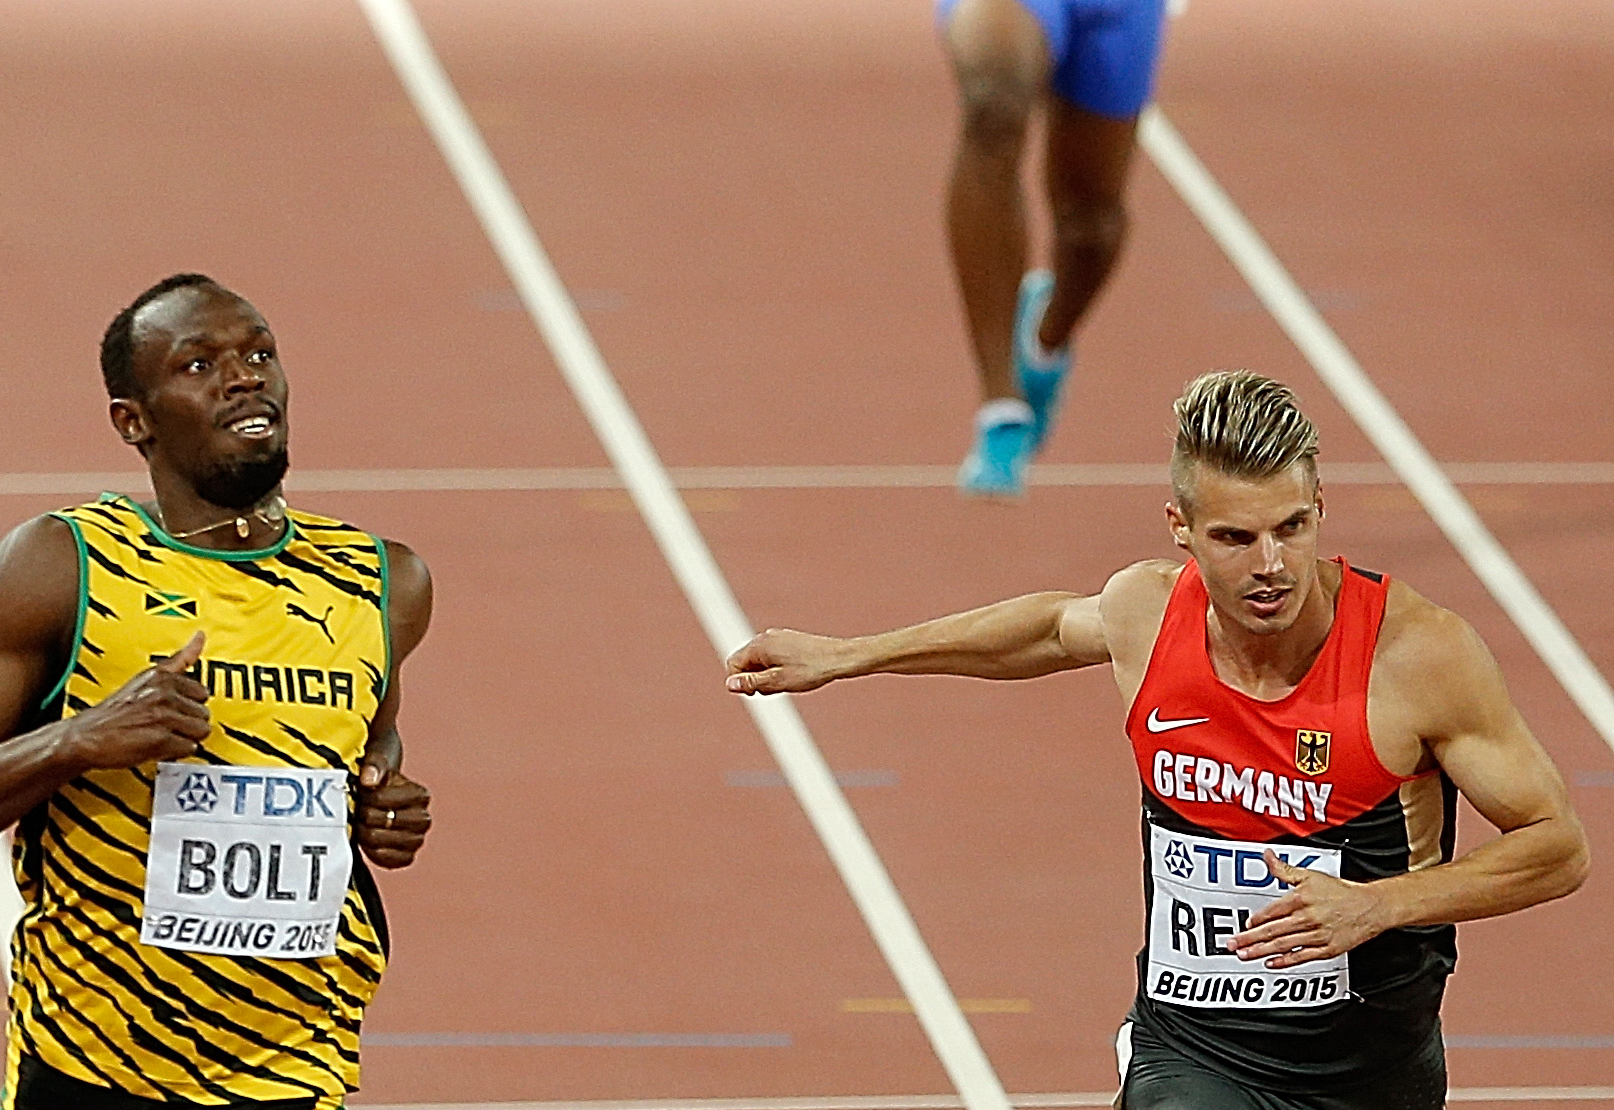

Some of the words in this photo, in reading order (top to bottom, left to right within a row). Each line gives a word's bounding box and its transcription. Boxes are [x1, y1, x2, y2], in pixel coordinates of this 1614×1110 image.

[150, 655, 354, 710] MAICA
[221, 774, 337, 819] TDK
[1153, 750, 1333, 823] GERMANY
[176, 839, 329, 903] BOLT
[152, 915, 276, 950] BEIJING
[1154, 971, 1265, 1003] BEIJING
[1270, 975, 1340, 1003] 2015
